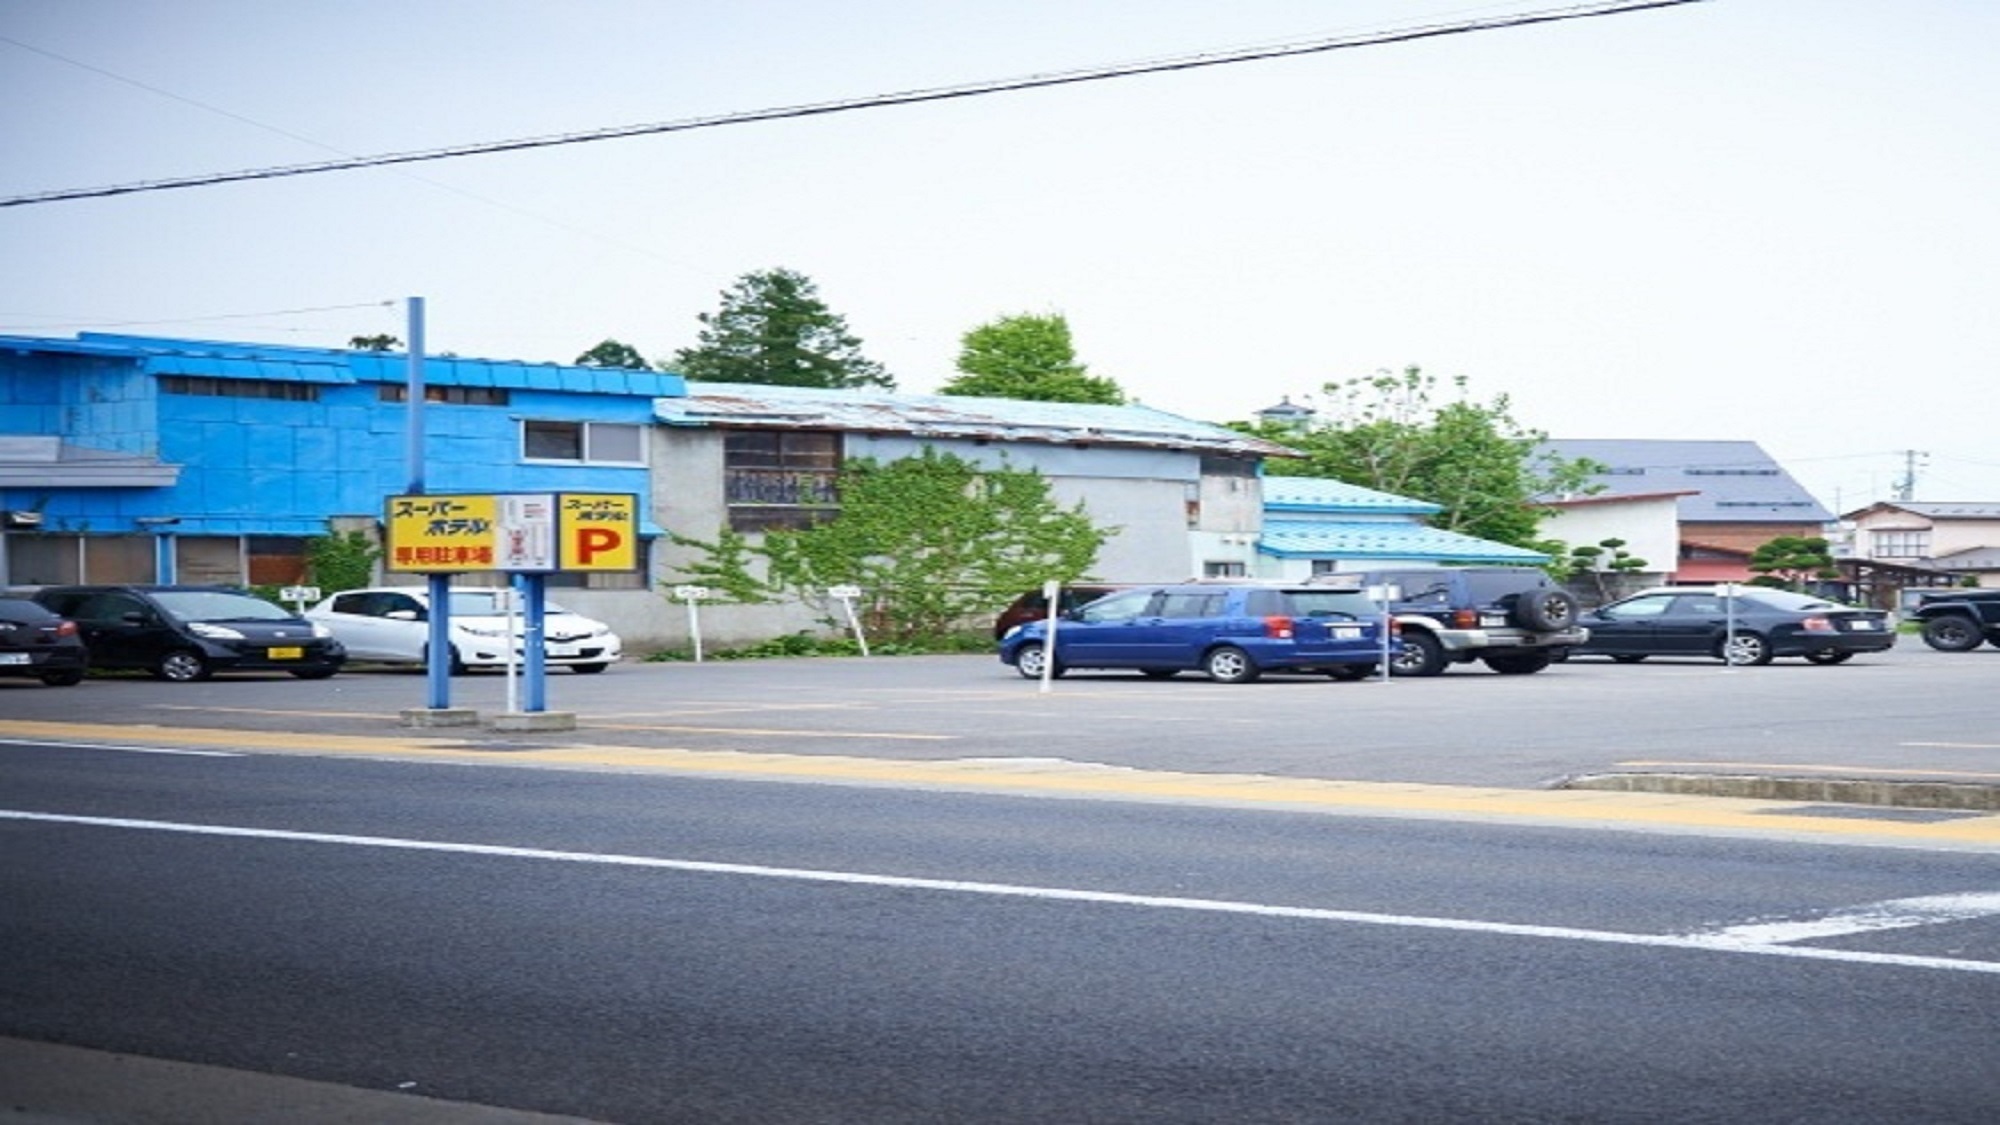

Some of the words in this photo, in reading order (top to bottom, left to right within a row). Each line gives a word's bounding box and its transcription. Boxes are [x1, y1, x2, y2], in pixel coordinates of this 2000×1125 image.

[395, 501, 468, 518] スーパー
[564, 499, 624, 510] スーパー
[424, 519, 490, 536] ホテル
[577, 528, 621, 565] P
